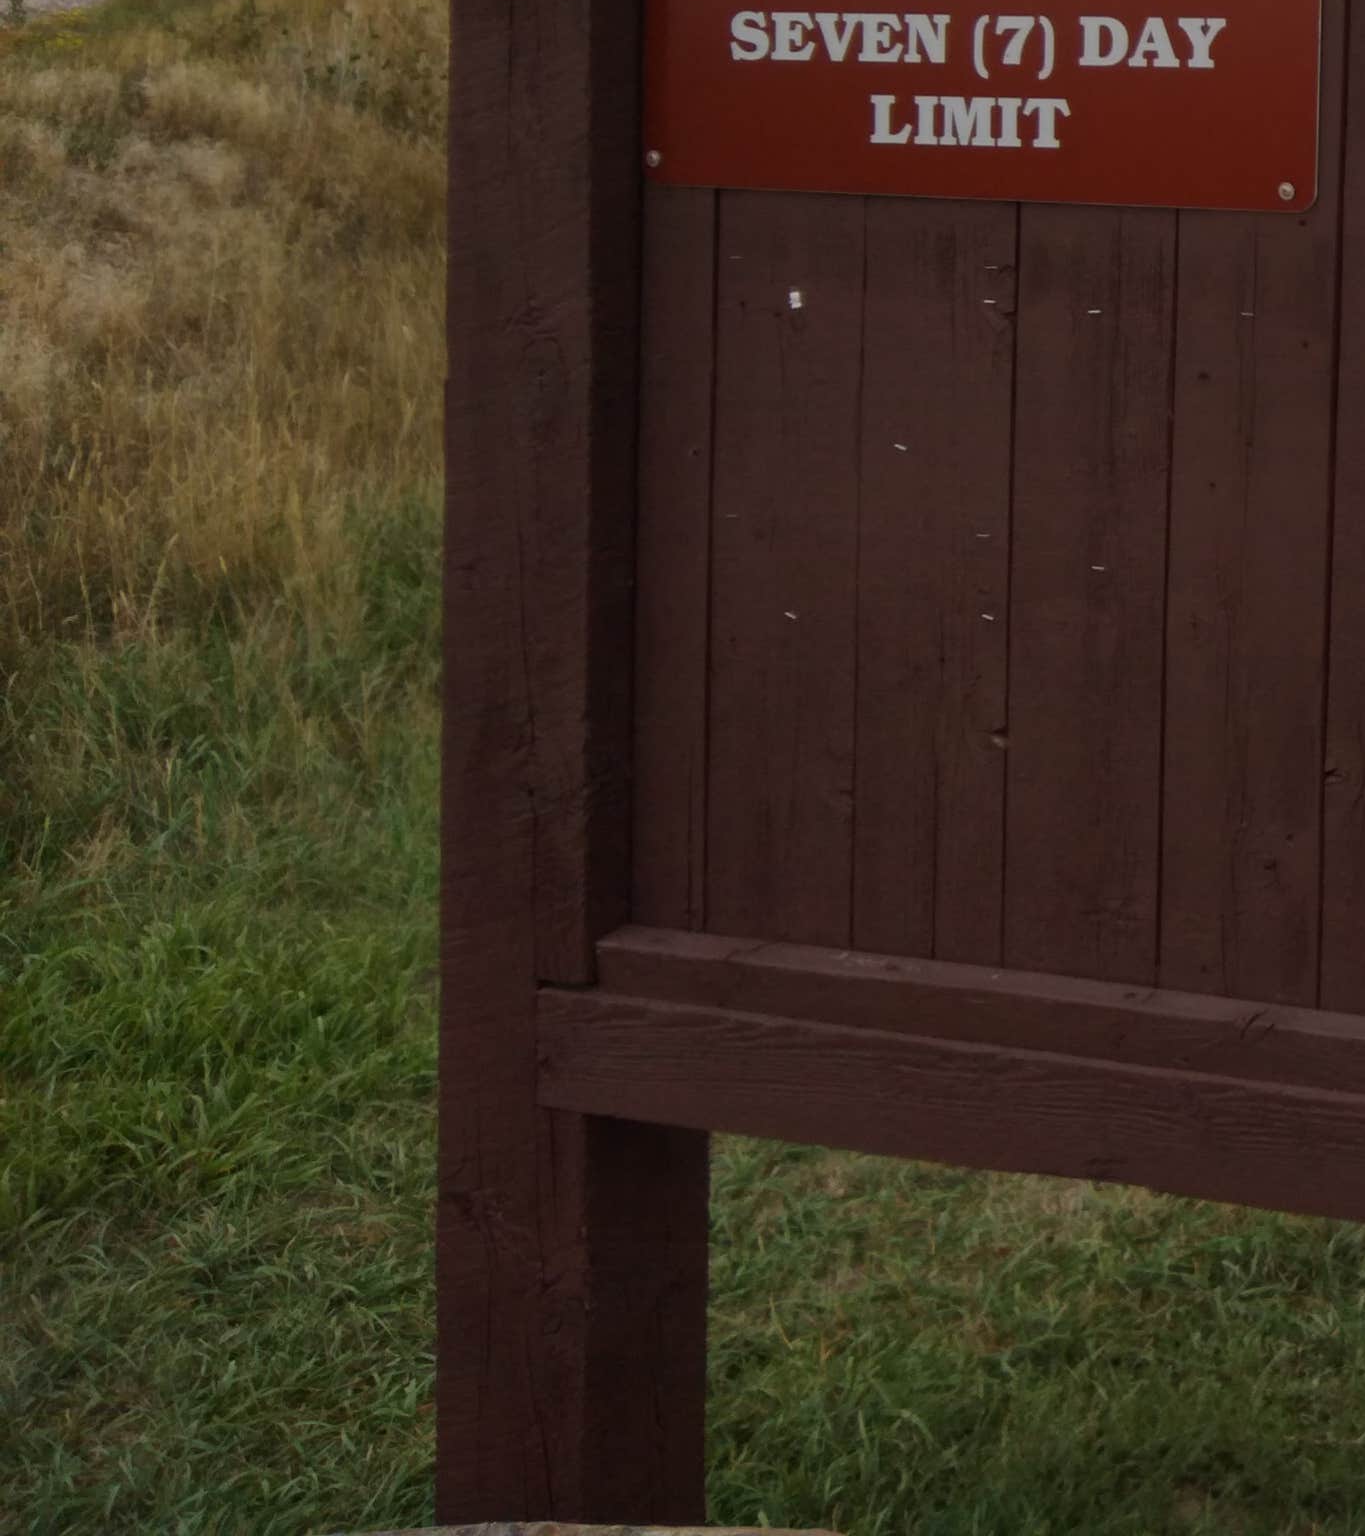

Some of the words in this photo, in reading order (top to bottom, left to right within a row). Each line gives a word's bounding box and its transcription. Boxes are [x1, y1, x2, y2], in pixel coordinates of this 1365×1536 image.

[730, 11, 950, 63] SEVEN
[973, 14, 1054, 80] (7)
[1078, 16, 1226, 68] DAY
[870, 94, 1070, 148] LIMIT
